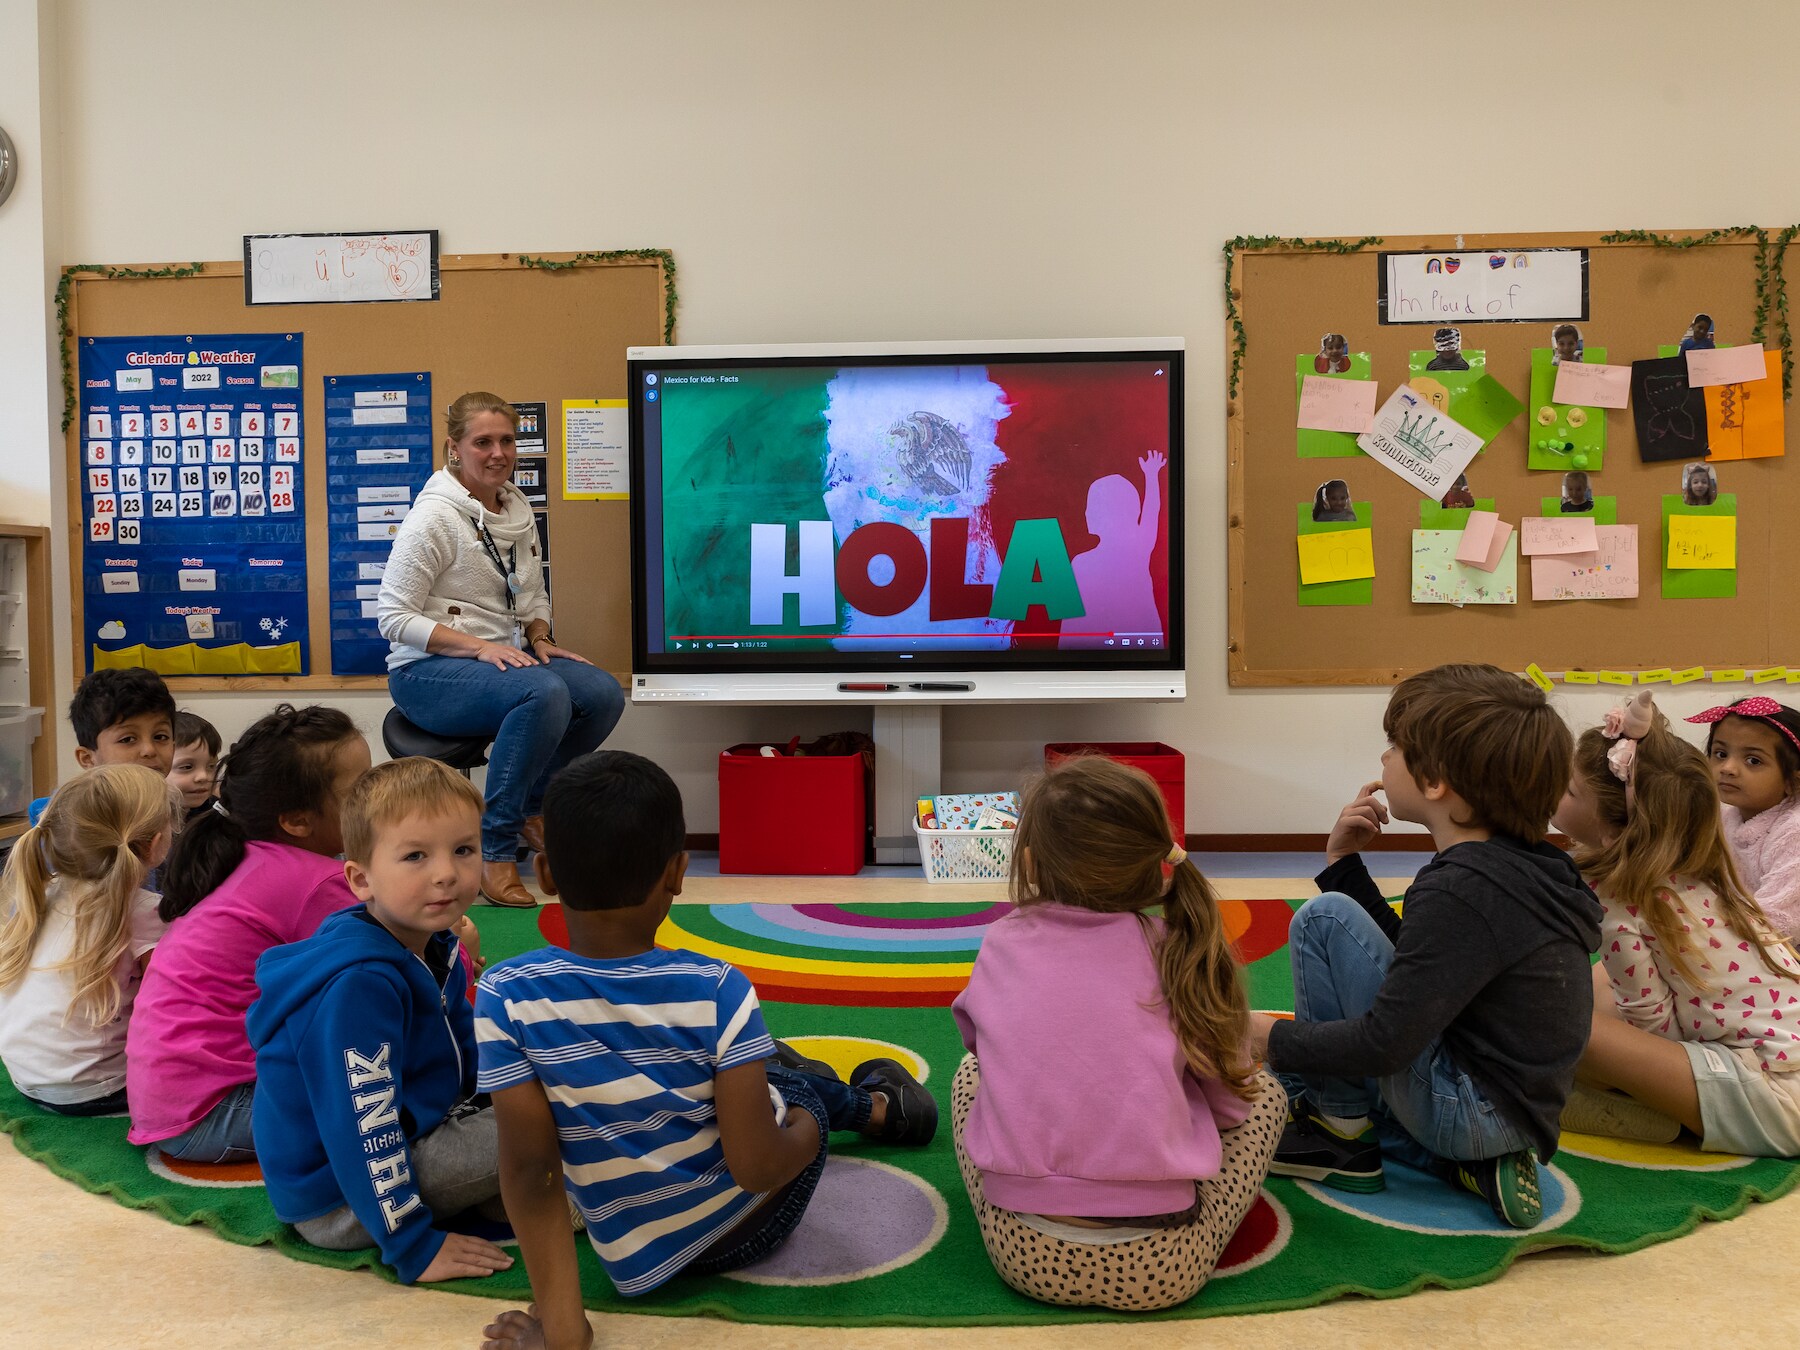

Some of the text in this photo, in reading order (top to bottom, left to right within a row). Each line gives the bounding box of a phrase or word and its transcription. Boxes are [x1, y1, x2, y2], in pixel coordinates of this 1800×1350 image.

[1486, 284, 1521, 314] of
[127, 350, 255, 365] Calendar & Weather
[87, 374, 255, 388] Month May Year 2022 Season
[664, 376, 688, 384] Mexico
[689, 375, 699, 384] for
[700, 375, 715, 383] Kids
[720, 374, 739, 383] Facts
[210, 403, 234, 411] Thursday
[98, 417, 291, 432] 1 2 3 4 5 6 7
[95, 443, 295, 460] 8 9 10 11 12 13 14
[1372, 434, 1441, 487] KONINGSDAG
[93, 471, 290, 487] 15 16 17 18 19 20 21
[97, 493, 292, 513] 22 23 24 25 NO NO 28
[93, 523, 138, 539] 29 30
[105, 558, 283, 567] Yesterday Today Tomorrow
[750, 518, 1086, 626] HOLA
[186, 577, 208, 585] Monday
[165, 607, 191, 615] Today's
